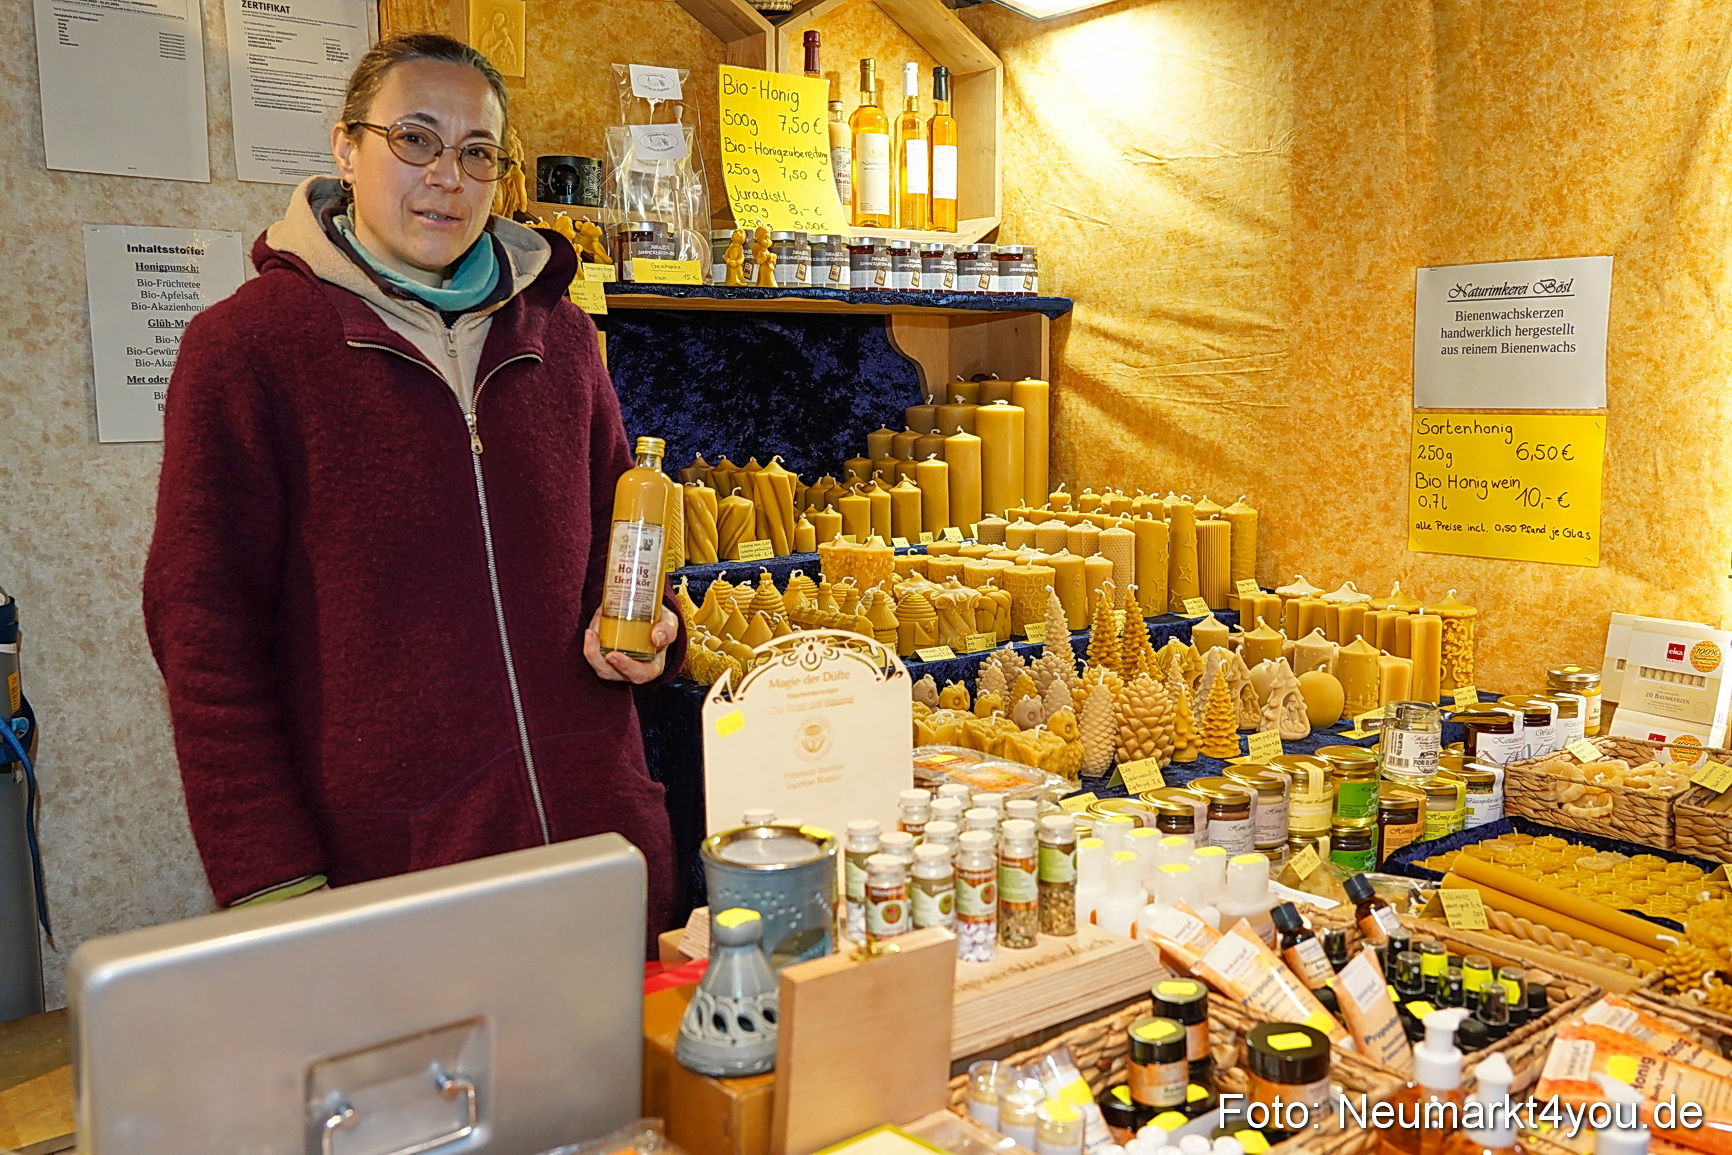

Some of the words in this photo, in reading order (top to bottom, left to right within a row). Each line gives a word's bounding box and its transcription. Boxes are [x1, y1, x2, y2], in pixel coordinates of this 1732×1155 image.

[241, 0, 291, 14] ZERTIFIKAT
[723, 73, 800, 112] Bio-Honig
[722, 109, 759, 136] 500g
[724, 137, 828, 166] Bio-Honigzubereitung
[730, 184, 791, 203] Juradistl
[126, 243, 206, 256] Inhaltsstoffe:
[135, 262, 200, 274] Honigpunsch:
[136, 278, 201, 289] Bio-Früchtetee
[1448, 281, 1530, 298] Naturimkerei
[1533, 278, 1575, 294] Bösl
[140, 290, 200, 301] Bio-Apfelsaft
[1454, 307, 1564, 322] Bienenwachskerzen
[148, 318, 189, 328] Glüh-Me
[1440, 326, 1512, 339] handwerklich
[1514, 322, 1576, 340] hergestellt
[154, 335, 182, 344] Bio-M
[126, 346, 179, 356] Bio-Gewürz
[1440, 344, 1459, 355] aus
[1461, 343, 1498, 354] reinem
[1500, 340, 1576, 354] Bienenwachs
[135, 358, 176, 368] Bio-Akaz
[126, 375, 146, 384] Met
[148, 375, 168, 384] oder
[1416, 418, 1514, 444] Sortenhonig
[1417, 444, 1453, 468] 250g
[1415, 472, 1442, 490] Bio
[1415, 520, 1432, 530] alle
[1434, 520, 1463, 532] Preise
[1467, 522, 1489, 533] incl.
[1494, 524, 1518, 534] 0,50
[1520, 524, 1547, 534] Pfand
[1549, 526, 1560, 540] je
[1562, 527, 1592, 540] Glas
[614, 576, 651, 587] Eierlkör
[768, 677, 801, 691] Magie
[803, 674, 820, 685] der
[823, 670, 850, 682] Düfte
